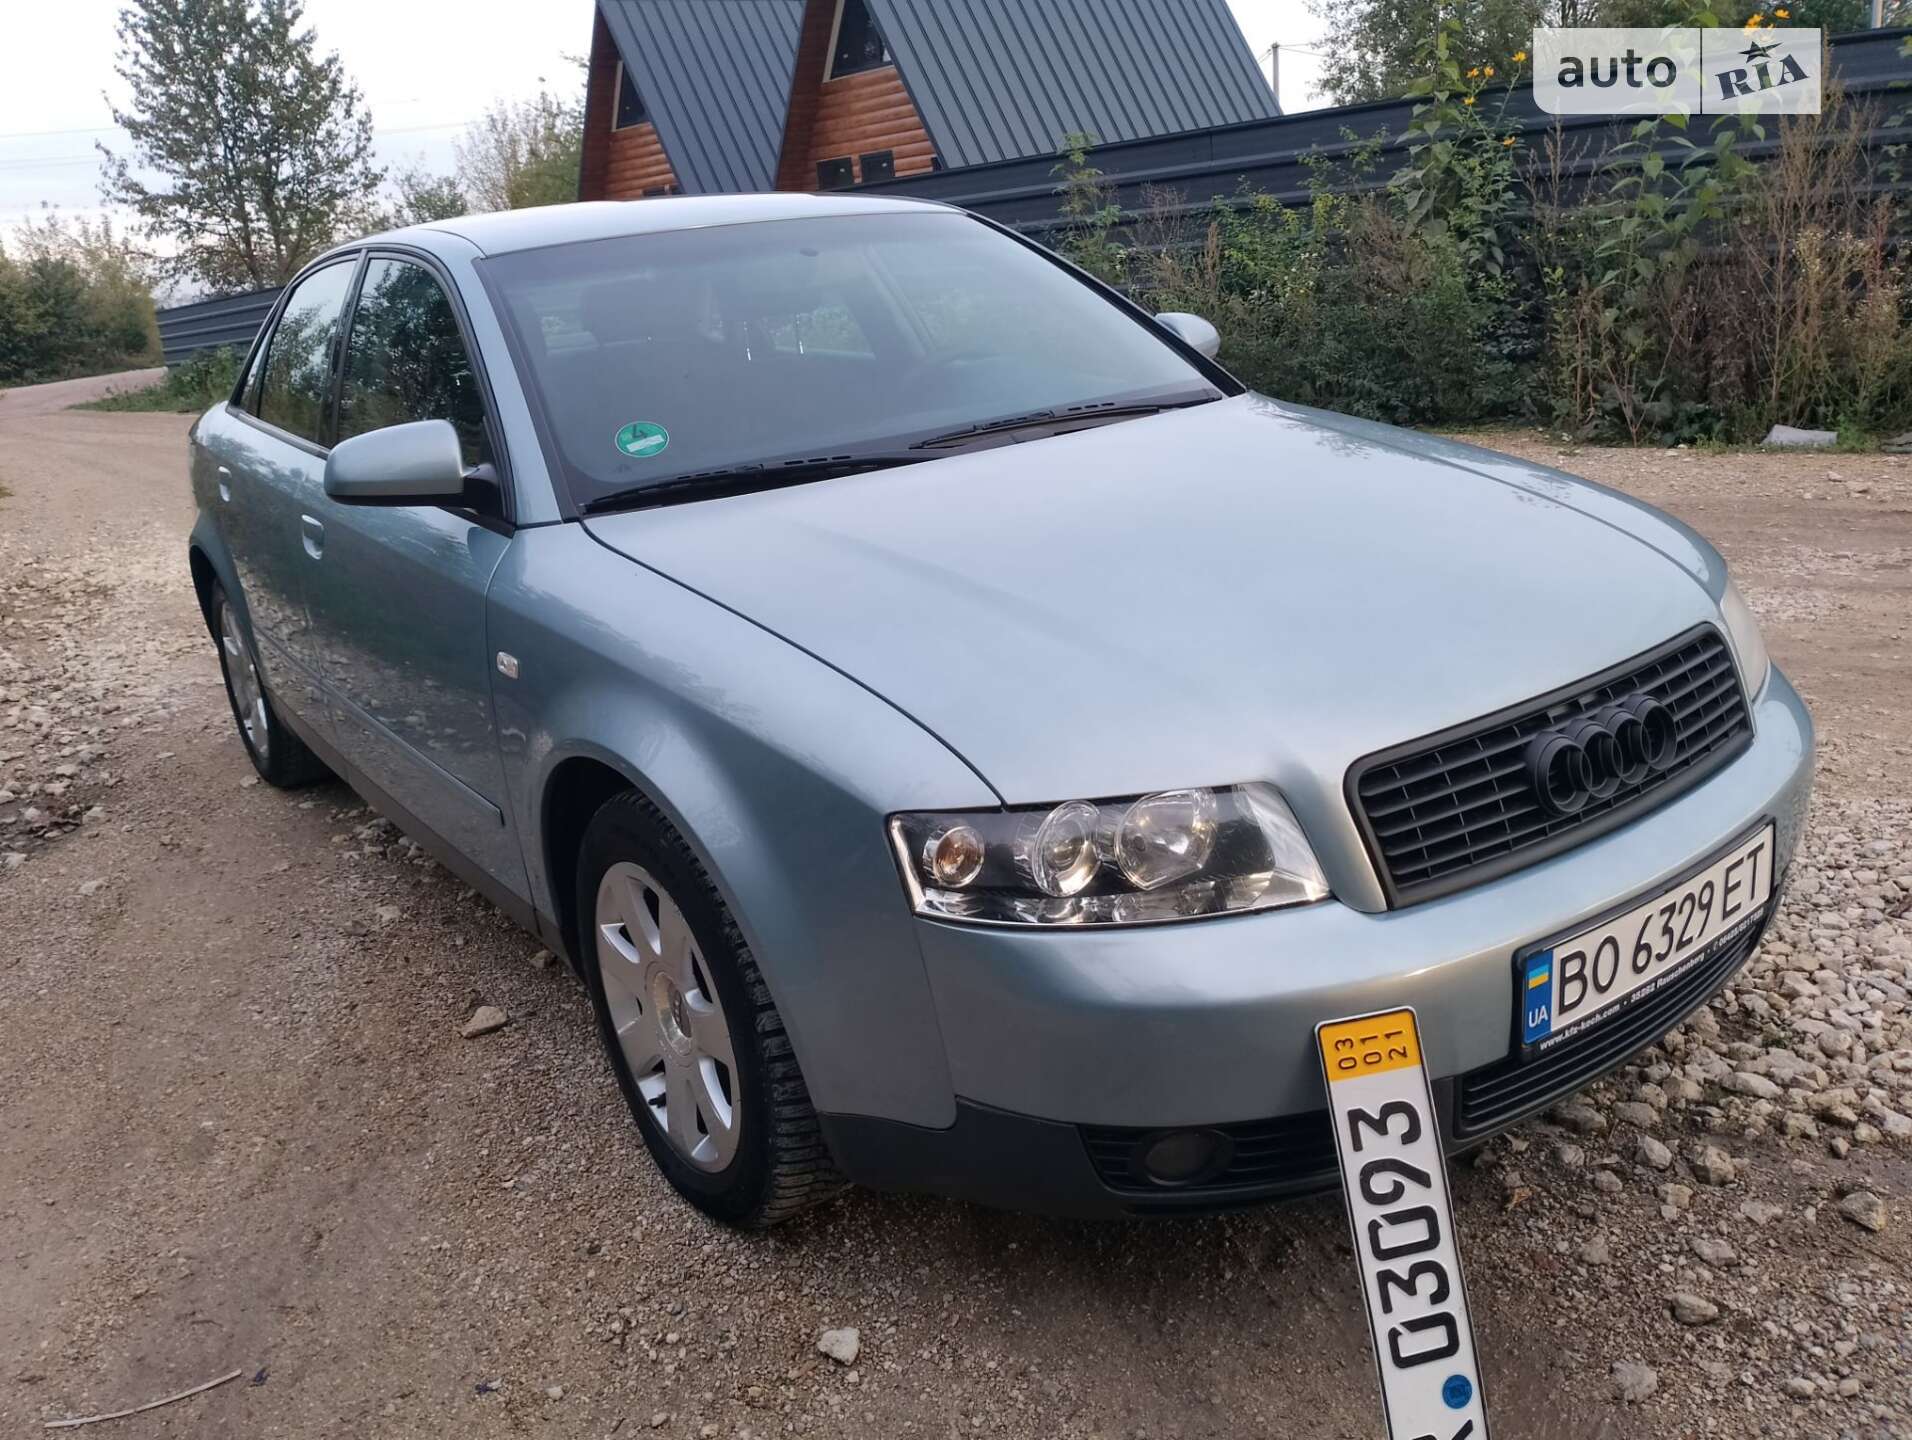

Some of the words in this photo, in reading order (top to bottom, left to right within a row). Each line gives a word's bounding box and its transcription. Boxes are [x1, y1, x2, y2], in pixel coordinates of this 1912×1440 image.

[1558, 935, 1620, 1017] BO
[1631, 880, 1715, 975] 6329
[1722, 841, 1765, 921] ET
[1528, 1005, 1549, 1028] UA
[1334, 1038, 1357, 1070] 03
[1360, 1035, 1382, 1065] 01
[1384, 1030, 1408, 1061] 21
[1346, 1100, 1460, 1370] 03093
